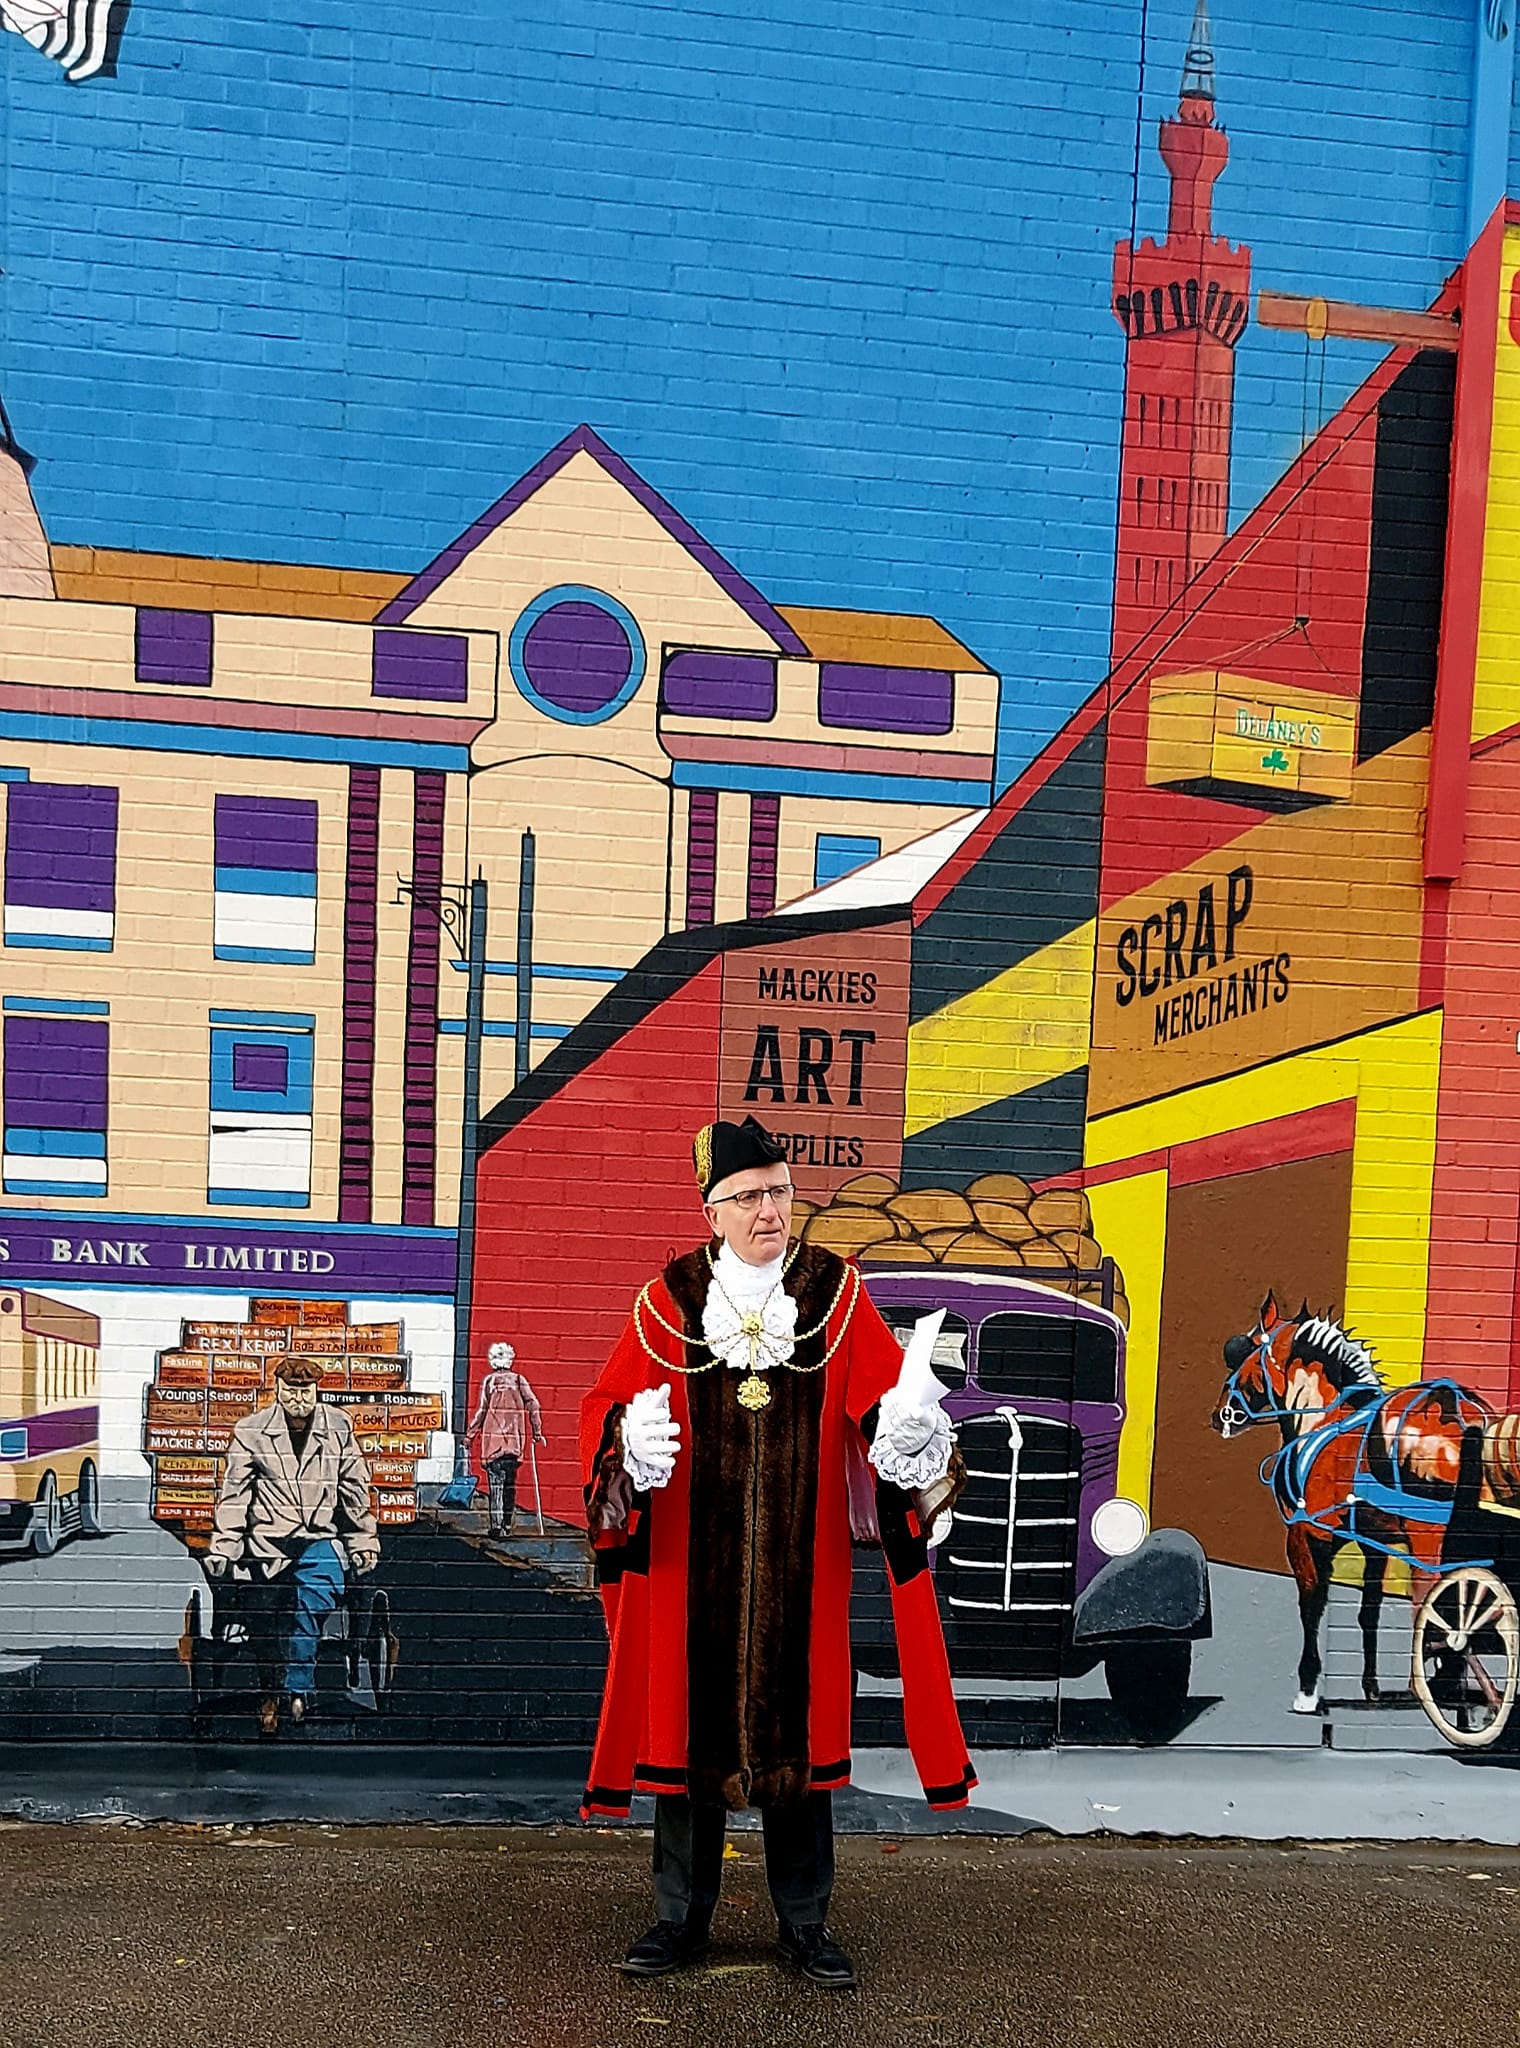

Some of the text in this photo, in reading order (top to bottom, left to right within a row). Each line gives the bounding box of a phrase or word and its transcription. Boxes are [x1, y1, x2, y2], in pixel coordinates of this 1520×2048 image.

[1236, 708, 1321, 745] DELANEY'S
[1115, 864, 1254, 1007] SCRAP
[758, 966, 877, 1004] MACKIES
[1153, 953, 1291, 1046] MERCHANTS
[743, 1024, 877, 1106] ART
[774, 1133, 864, 1168] PPLIES
[51, 1239, 151, 1268] BANK
[184, 1245, 335, 1273] LIMITED
[263, 1327, 286, 1338] Sons
[200, 1338, 285, 1352] REX KEMP
[156, 1390, 254, 1403] Youngs Seafood
[384, 1394, 432, 1406] Roberts
[401, 1414, 438, 1426] LUCAS
[151, 1436, 230, 1451] MACKIE & SON
[363, 1440, 425, 1454] DK FISH
[376, 1463, 414, 1473] GRIMSBY
[383, 1511, 411, 1522] FISH
